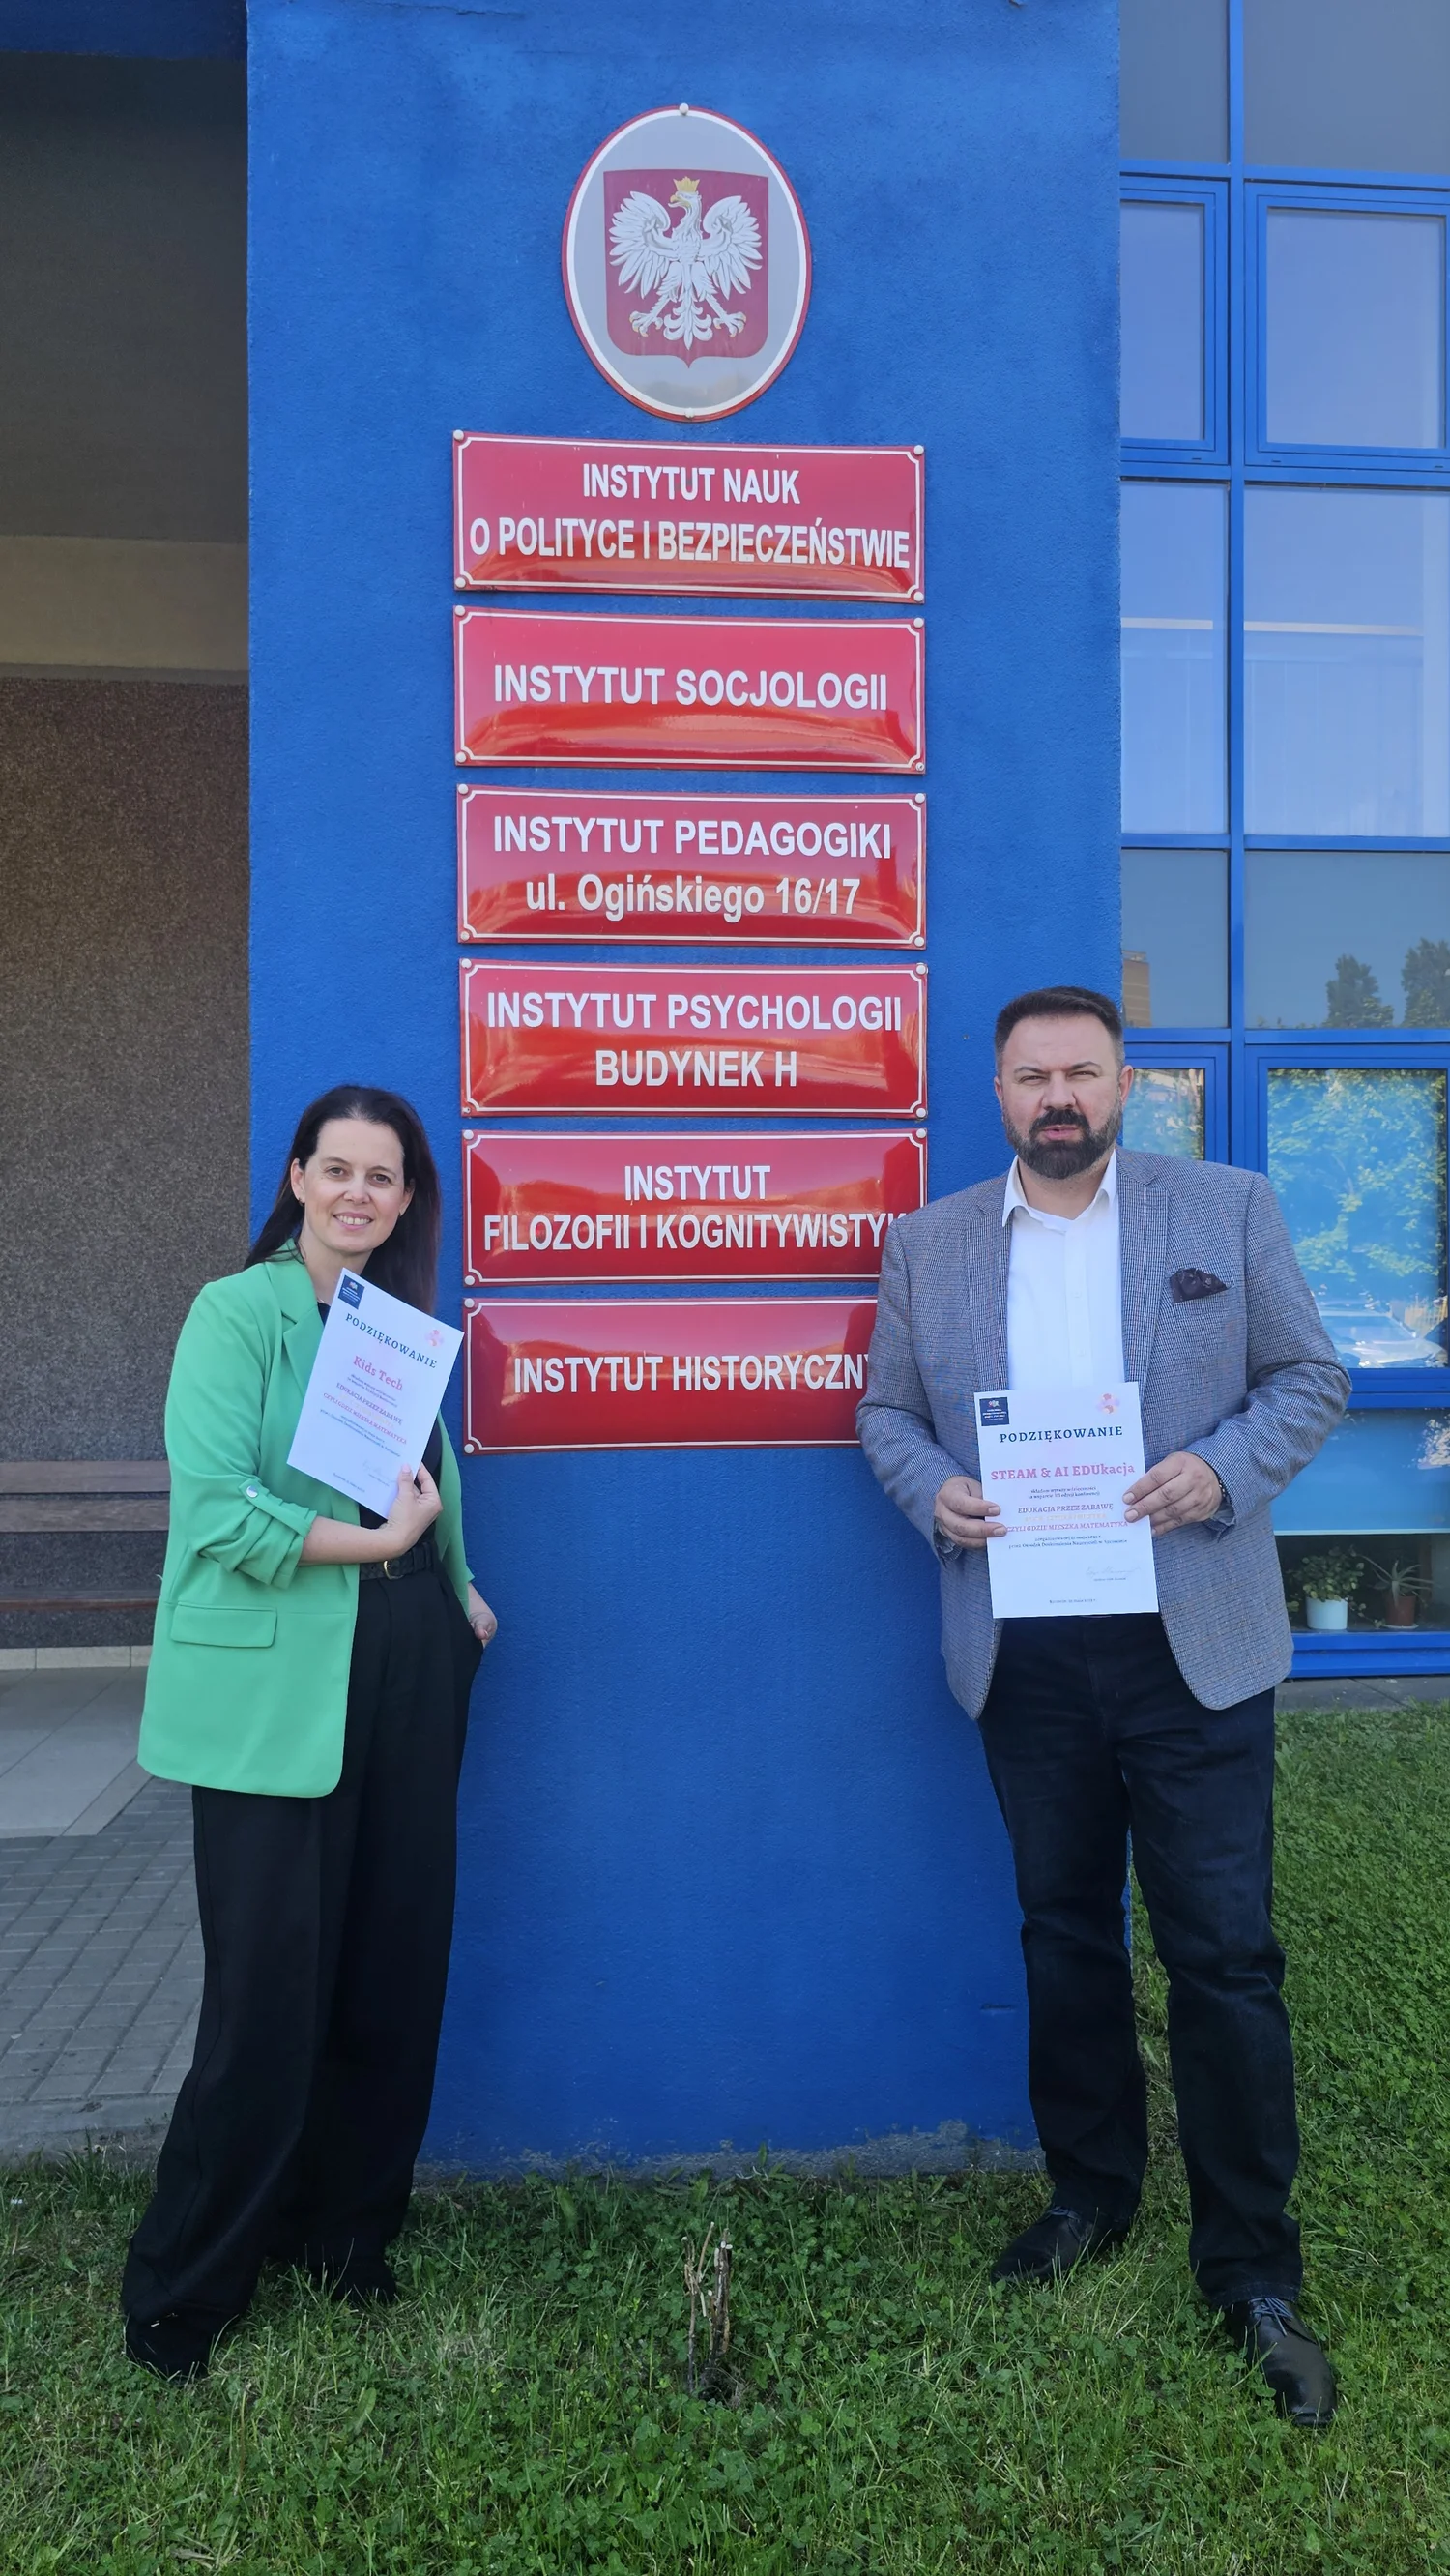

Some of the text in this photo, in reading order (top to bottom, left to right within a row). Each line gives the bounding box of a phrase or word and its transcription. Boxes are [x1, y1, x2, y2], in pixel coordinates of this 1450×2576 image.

[583, 463, 801, 505] INSTYTUT NAUK
[469, 516, 910, 569] O POLITYCE I BEZPIECZEŃSTWIE
[494, 664, 887, 711] INSTYTUT SOCJOLOGII
[494, 815, 891, 859] INSTYTUT PEDAGOGIKI
[526, 872, 860, 923] ul. Ogińskiego 16/17
[487, 991, 902, 1031] INSTYTUT PSYCHOLOGII
[595, 1049, 798, 1087] BUDYNEK H
[624, 1165, 771, 1201] INSTYTUT
[484, 1215, 630, 1251] FILOZOFII
[640, 1214, 647, 1249] I
[345, 1313, 438, 1369] PODZIĘKOWANIE
[353, 1355, 377, 1376] Kids
[379, 1369, 403, 1391] Tech
[514, 1353, 869, 1393] INSTYTUT HISTORYCZN
[1000, 1426, 1123, 1443] PODZIĘKOWANIE
[991, 1462, 1135, 1480] STEAM & AI EDUkacja
